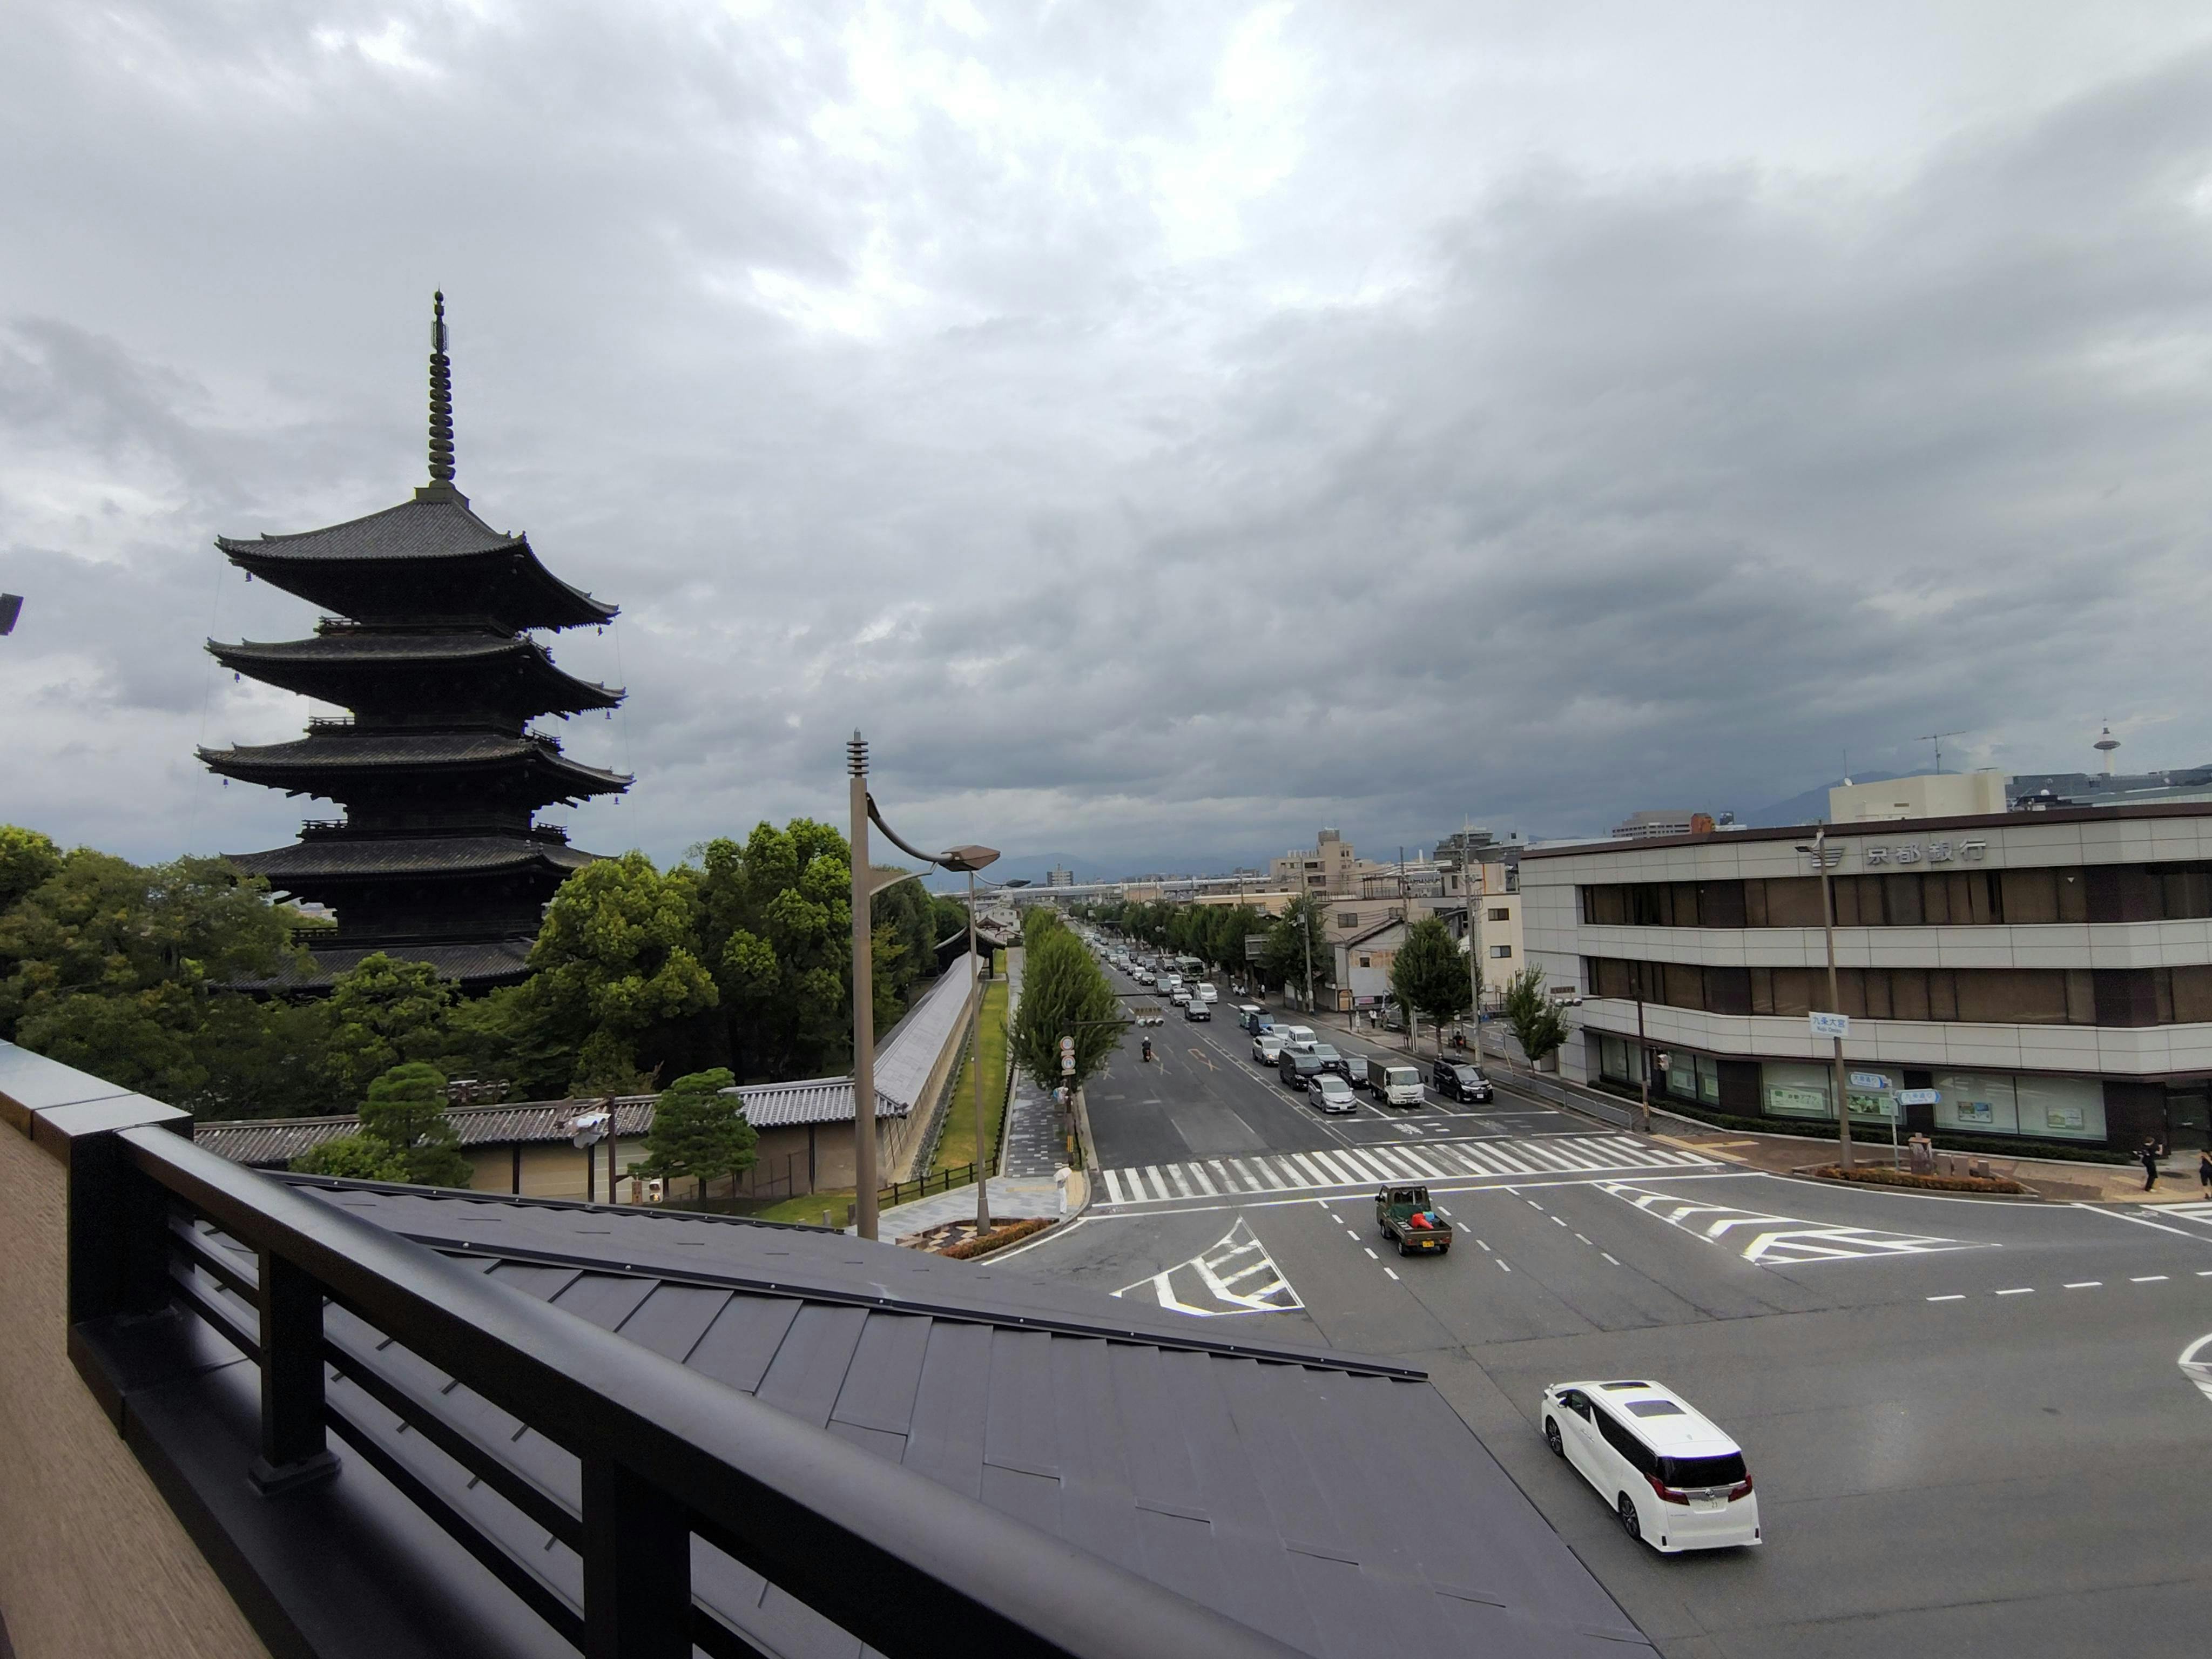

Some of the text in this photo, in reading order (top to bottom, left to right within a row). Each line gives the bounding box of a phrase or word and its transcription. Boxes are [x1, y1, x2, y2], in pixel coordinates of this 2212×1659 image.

[1867, 838, 1986, 865] 京都銀行
[1813, 1016, 1845, 1028] 九条大宮
